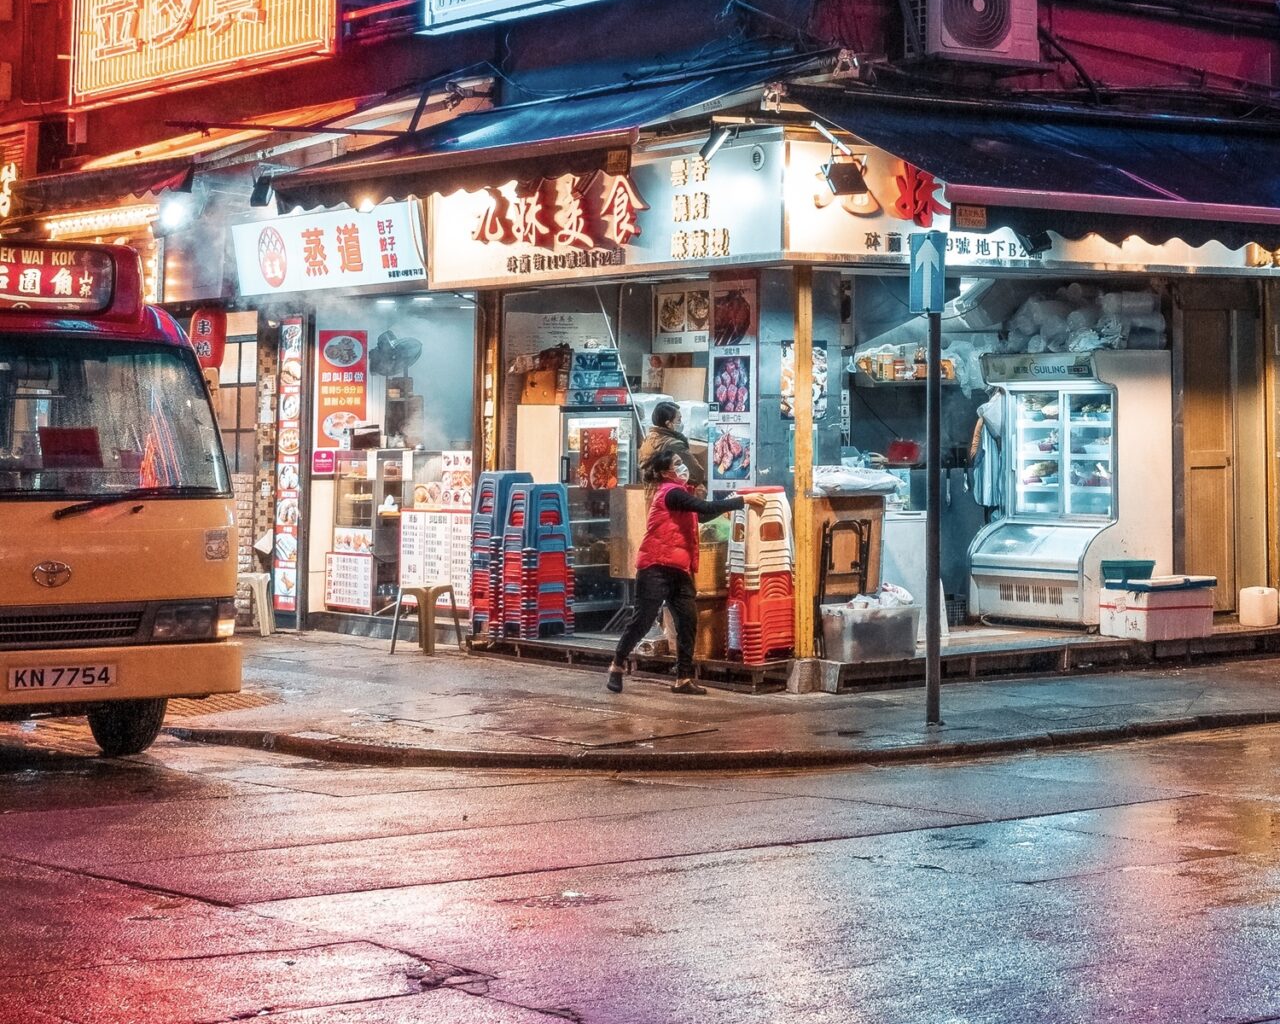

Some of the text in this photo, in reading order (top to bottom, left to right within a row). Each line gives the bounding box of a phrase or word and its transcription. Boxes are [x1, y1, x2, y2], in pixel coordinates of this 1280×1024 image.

[21, 249, 44, 264] WAI
[52, 251, 76, 266] KOK
[301, 223, 364, 276] 蒸道
[196, 320, 212, 358] 串燒
[1034, 365, 1066, 374] SUILING
[14, 666, 111, 687] KN 7754
